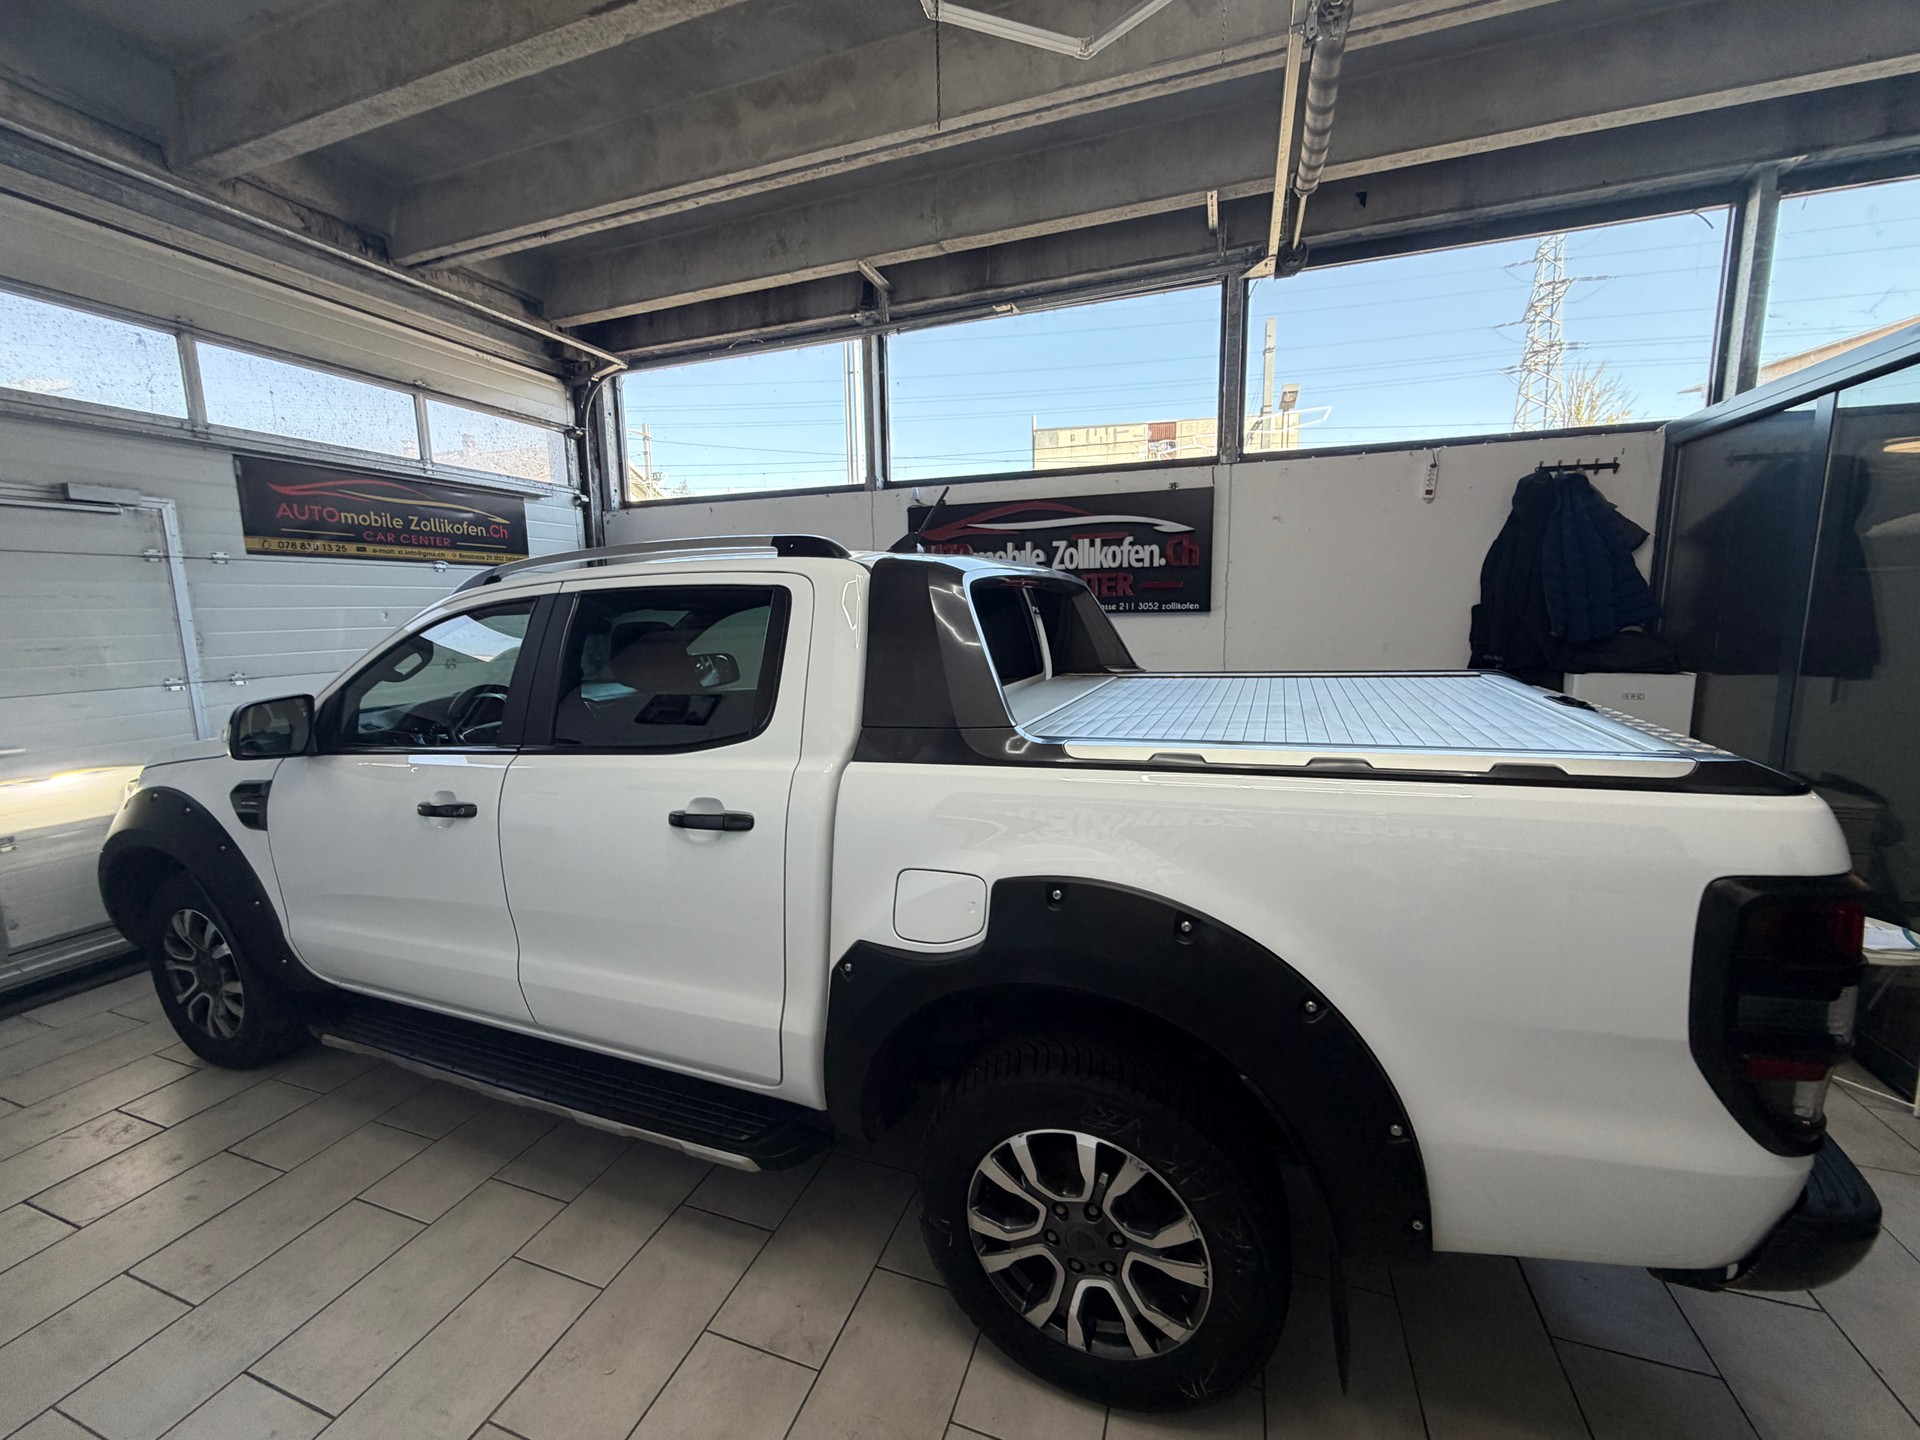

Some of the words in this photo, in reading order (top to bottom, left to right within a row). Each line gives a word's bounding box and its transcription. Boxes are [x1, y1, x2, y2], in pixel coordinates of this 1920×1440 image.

[276, 502, 403, 529] AUTOmobile
[408, 515, 508, 539] Zollikofen.Ch
[277, 540, 297, 549] 078
[322, 543, 333, 552] 13
[335, 544, 347, 552] 25
[363, 531, 396, 542] CAR
[400, 534, 451, 547] CENTER
[1082, 572, 1134, 597] TER
[1119, 602, 1135, 610] 211
[1138, 602, 1159, 610] 3052
[1161, 602, 1200, 610] zollikofen
